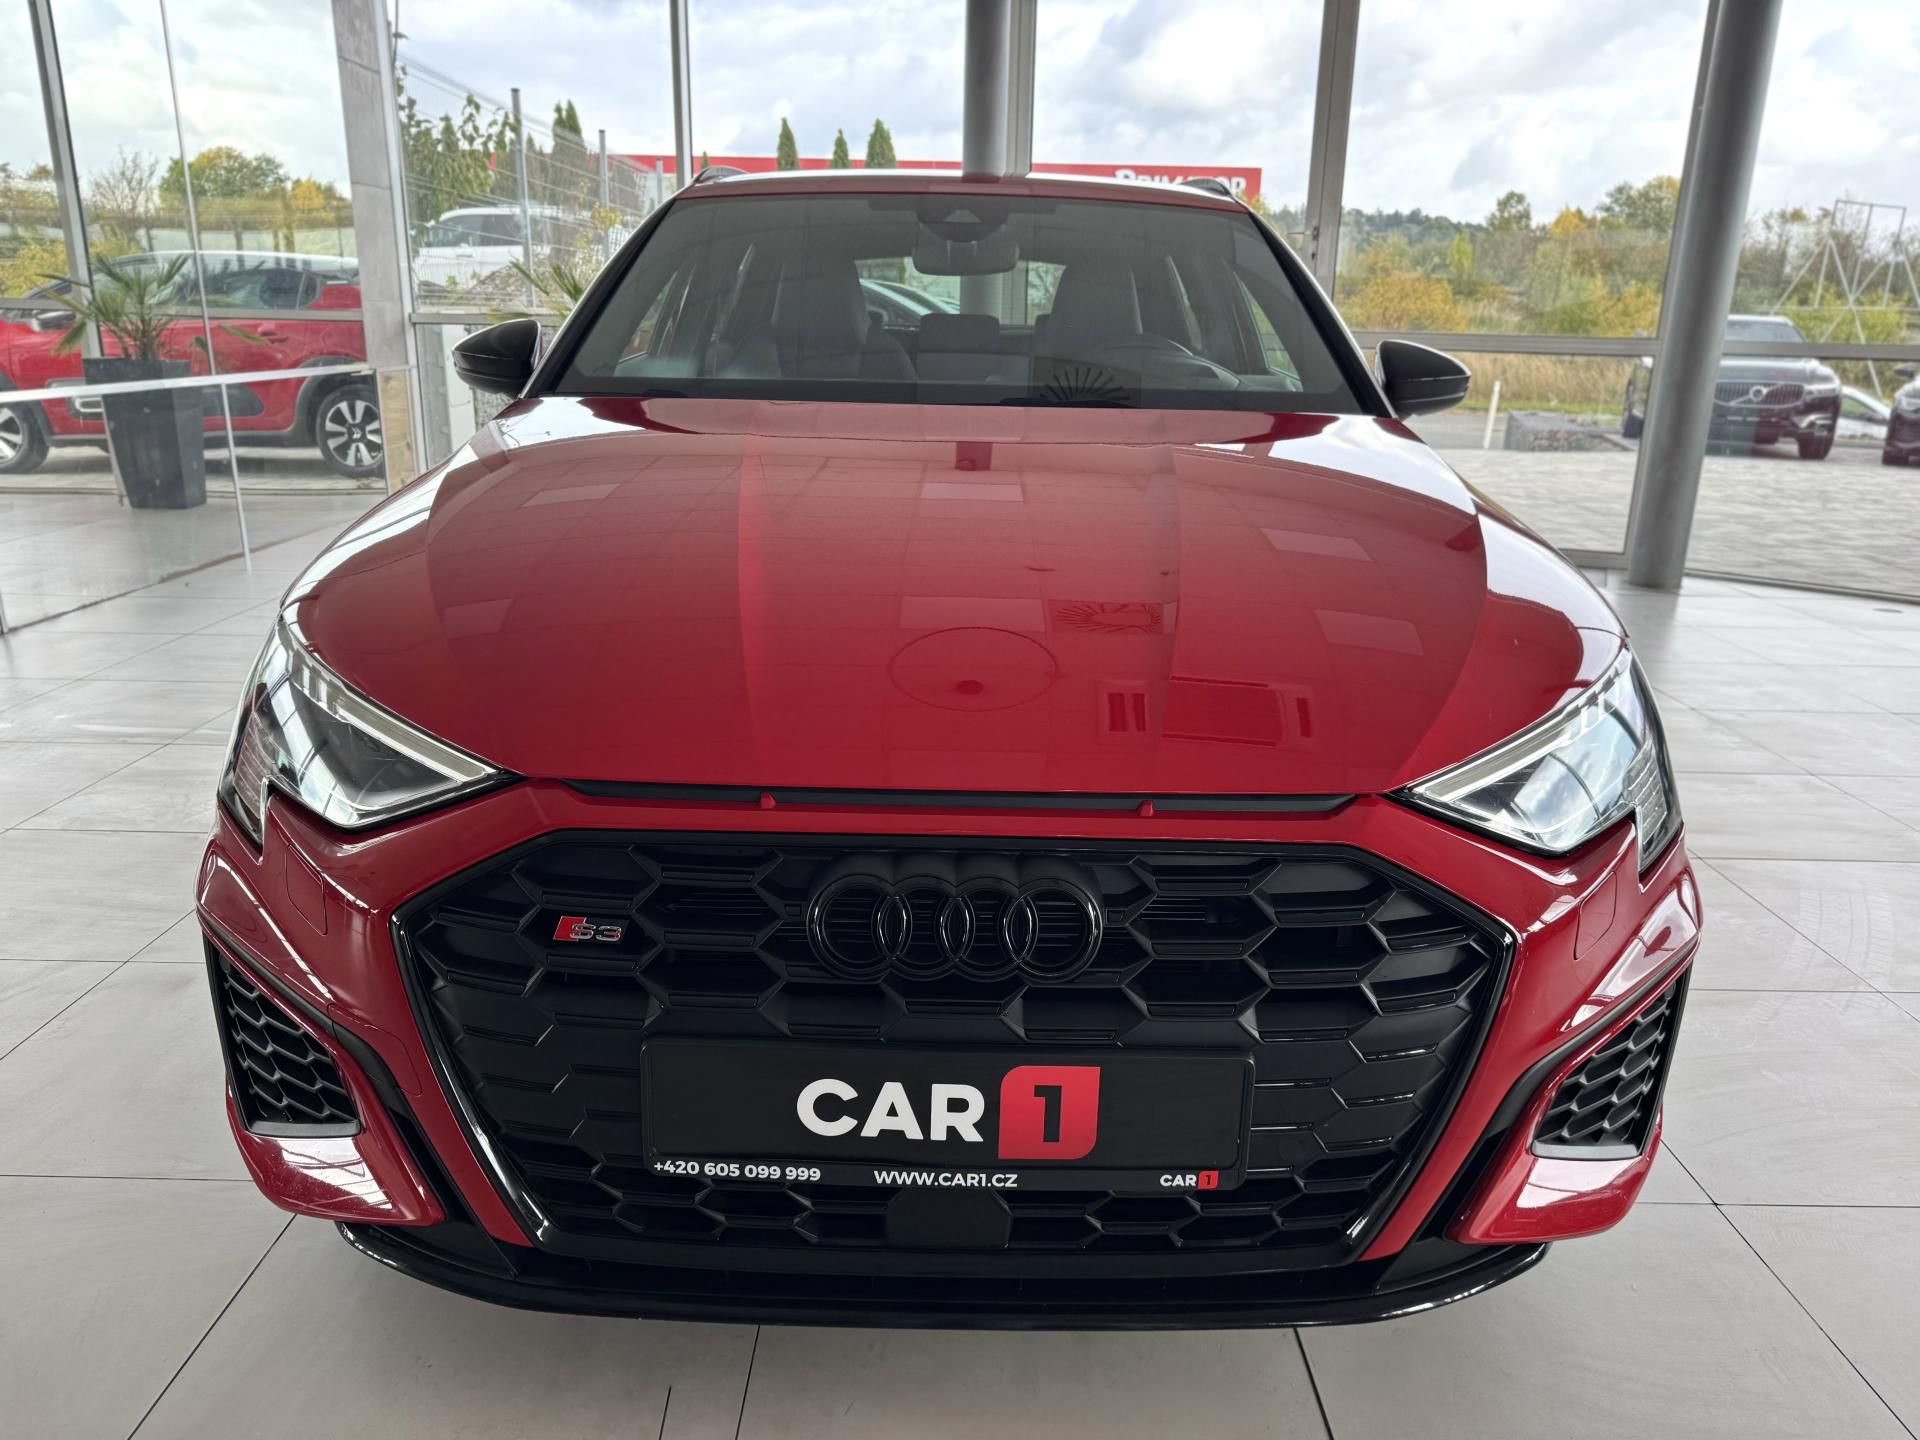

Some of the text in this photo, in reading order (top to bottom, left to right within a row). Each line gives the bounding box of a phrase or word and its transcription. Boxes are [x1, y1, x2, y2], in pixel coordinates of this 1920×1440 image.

[569, 923, 622, 941] S3
[796, 1078, 985, 1142] CAR
[653, 1160, 821, 1181] +420 605 099 999
[873, 1170, 1018, 1188] WWW.CAR1.CZ
[1159, 1174, 1197, 1187] CAR
